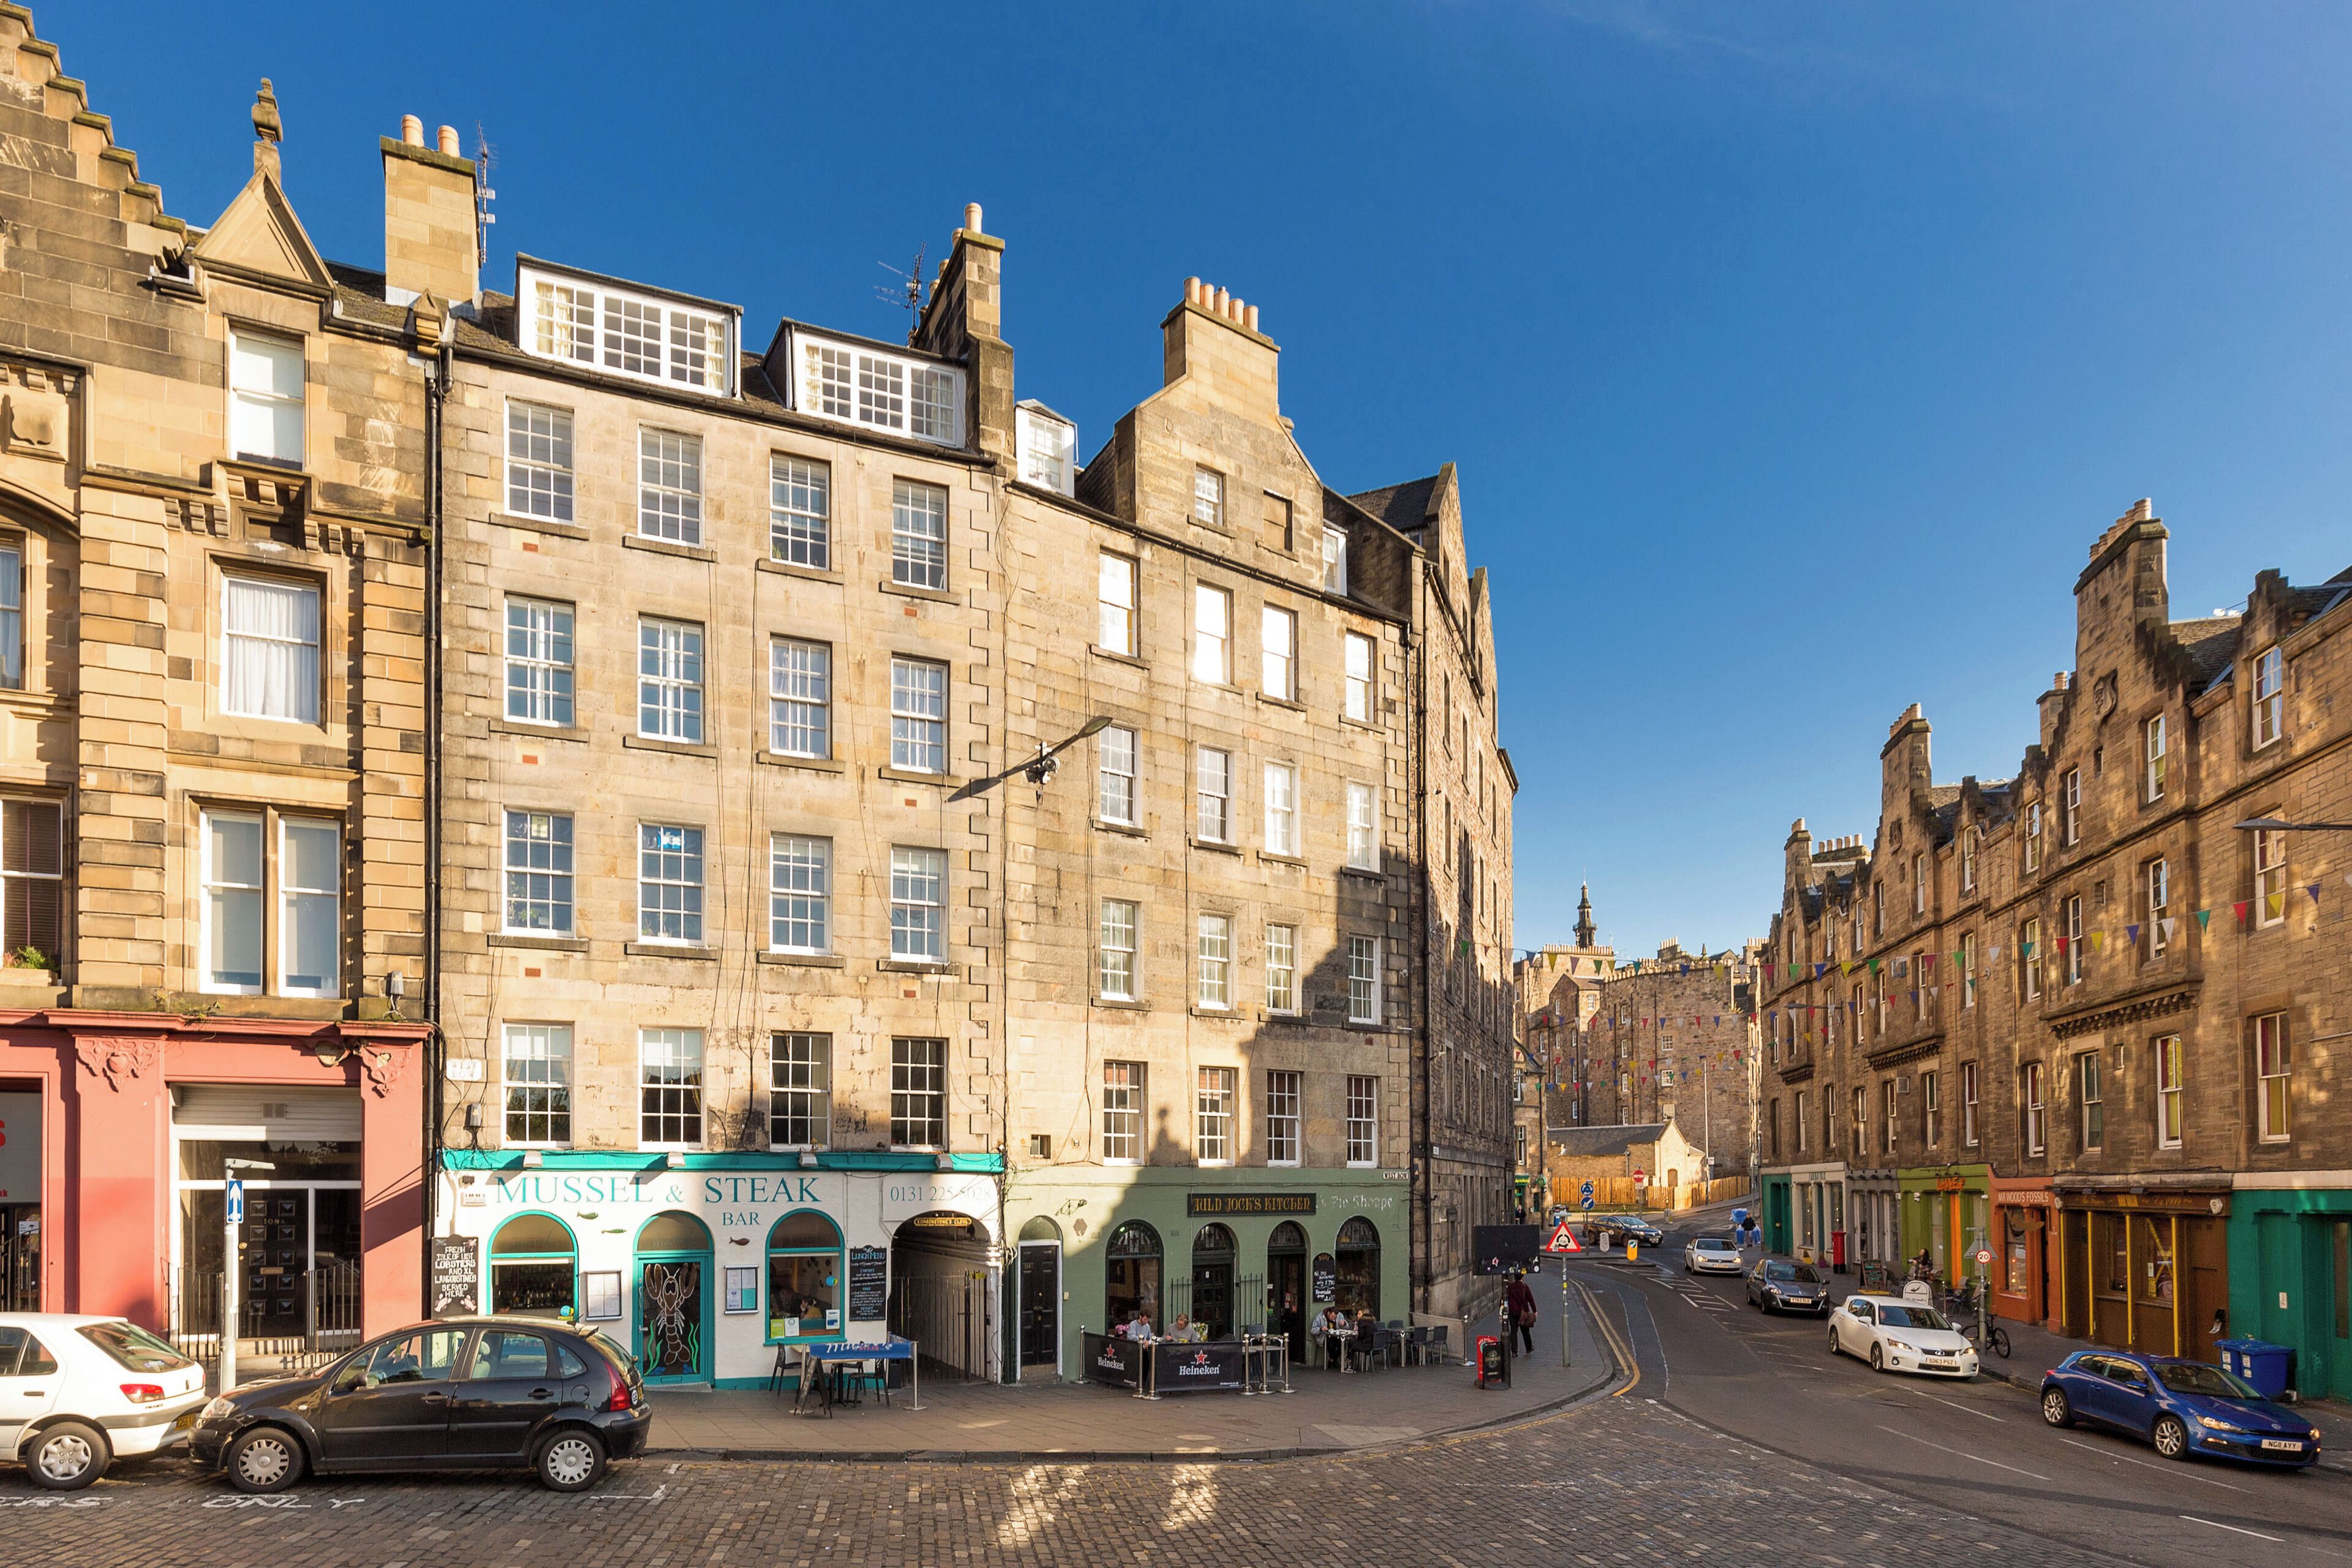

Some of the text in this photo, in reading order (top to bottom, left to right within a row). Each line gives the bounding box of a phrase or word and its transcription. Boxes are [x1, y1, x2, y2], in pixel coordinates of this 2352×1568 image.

[495, 1176, 823, 1204] MUSSEL & STEAK
[890, 1186, 922, 1202] 0131
[929, 1186, 954, 1202] 225
[1998, 1192, 2007, 1201] MR
[2026, 1191, 2049, 1202] FOSSILS
[1193, 1197, 1310, 1212] AULD JOCK'S KITCHEN
[722, 1212, 760, 1226] BAR
[435, 1259, 476, 1269] LOBSTERS
[1098, 1356, 1125, 1371] Heineken
[1179, 1365, 1220, 1376] Heineken
